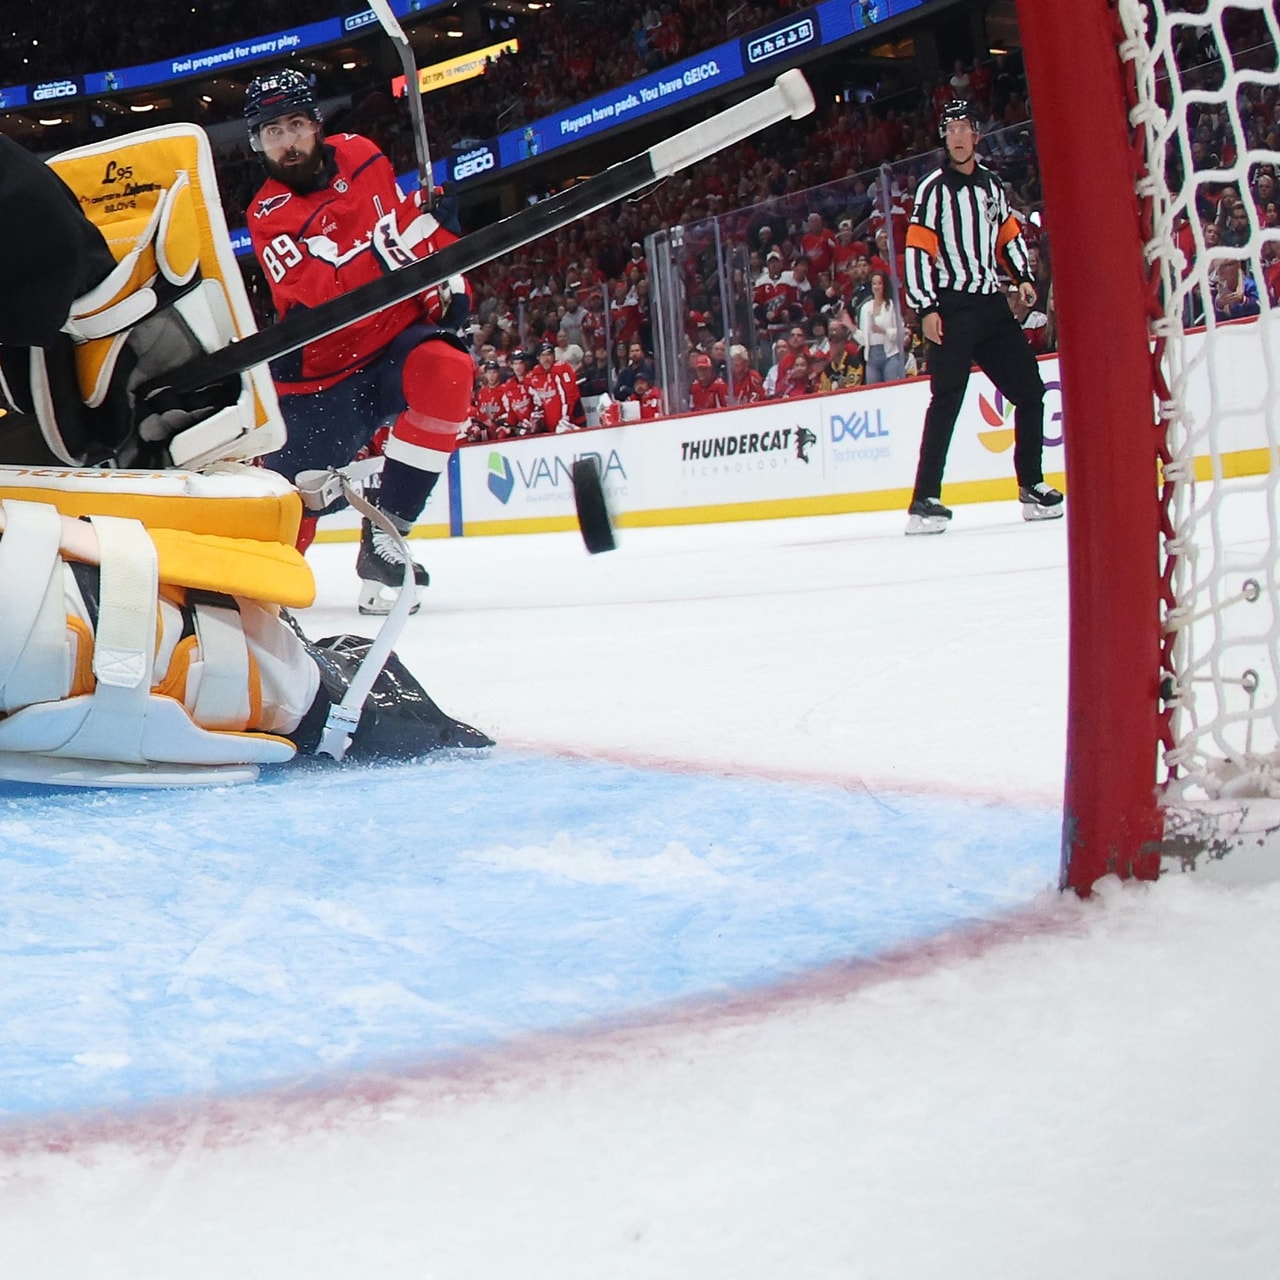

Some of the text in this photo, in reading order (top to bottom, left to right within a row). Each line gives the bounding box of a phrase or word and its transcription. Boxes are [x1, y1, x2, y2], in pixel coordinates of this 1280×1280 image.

[33, 84, 77, 101] GEICO
[560, 114, 592, 134] Players
[592, 104, 614, 122] have
[640, 86, 659, 103] You
[658, 78, 684, 97] have
[683, 61, 721, 86] GEICO.
[261, 234, 304, 283] 89
[831, 408, 888, 443] DELL
[682, 429, 791, 461] THUNDERCAT
[832, 444, 891, 461] Technologies
